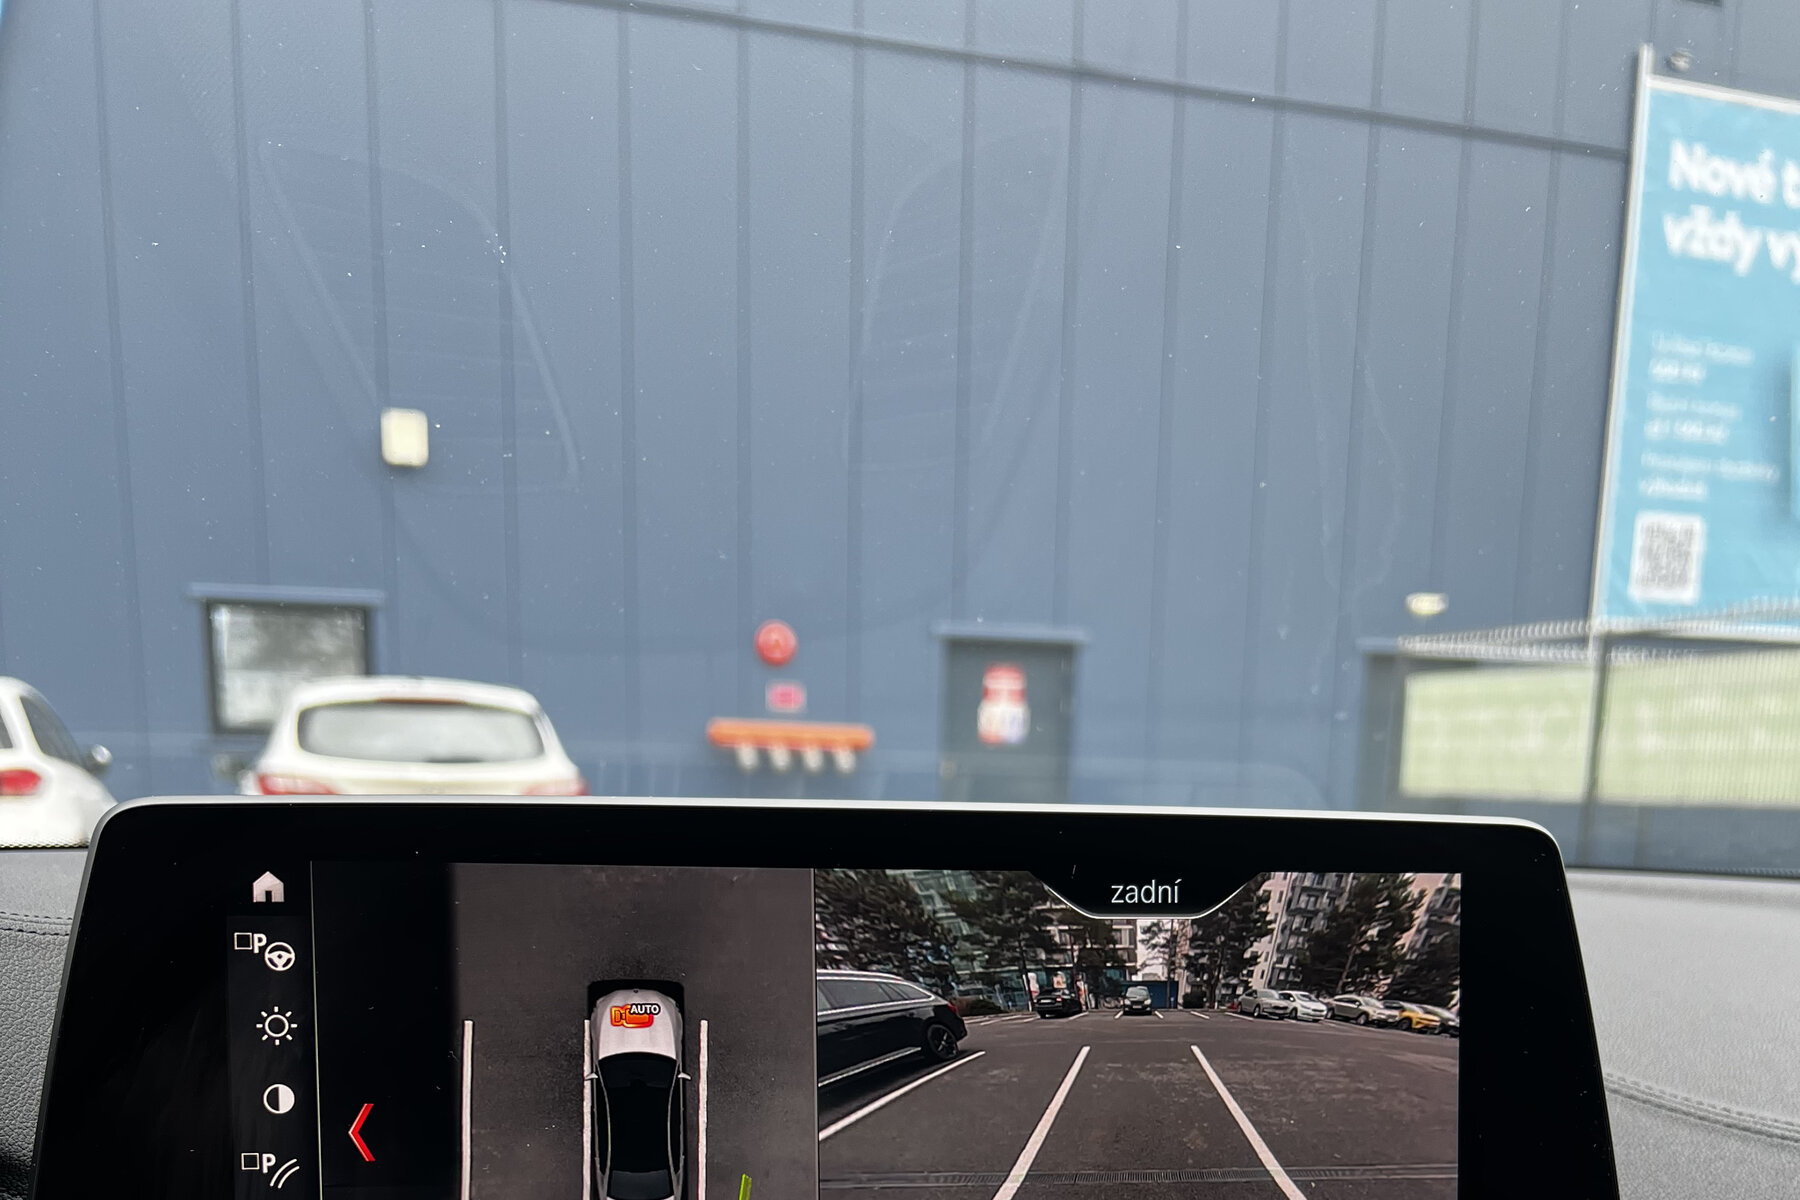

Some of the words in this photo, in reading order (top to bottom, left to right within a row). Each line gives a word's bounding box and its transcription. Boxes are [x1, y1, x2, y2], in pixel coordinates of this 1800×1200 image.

[1667, 139, 1777, 205] Nové
[1111, 878, 1182, 904] zadní
[253, 933, 267, 954] P
[630, 1004, 660, 1014] AUTO
[262, 1153, 277, 1174] P
